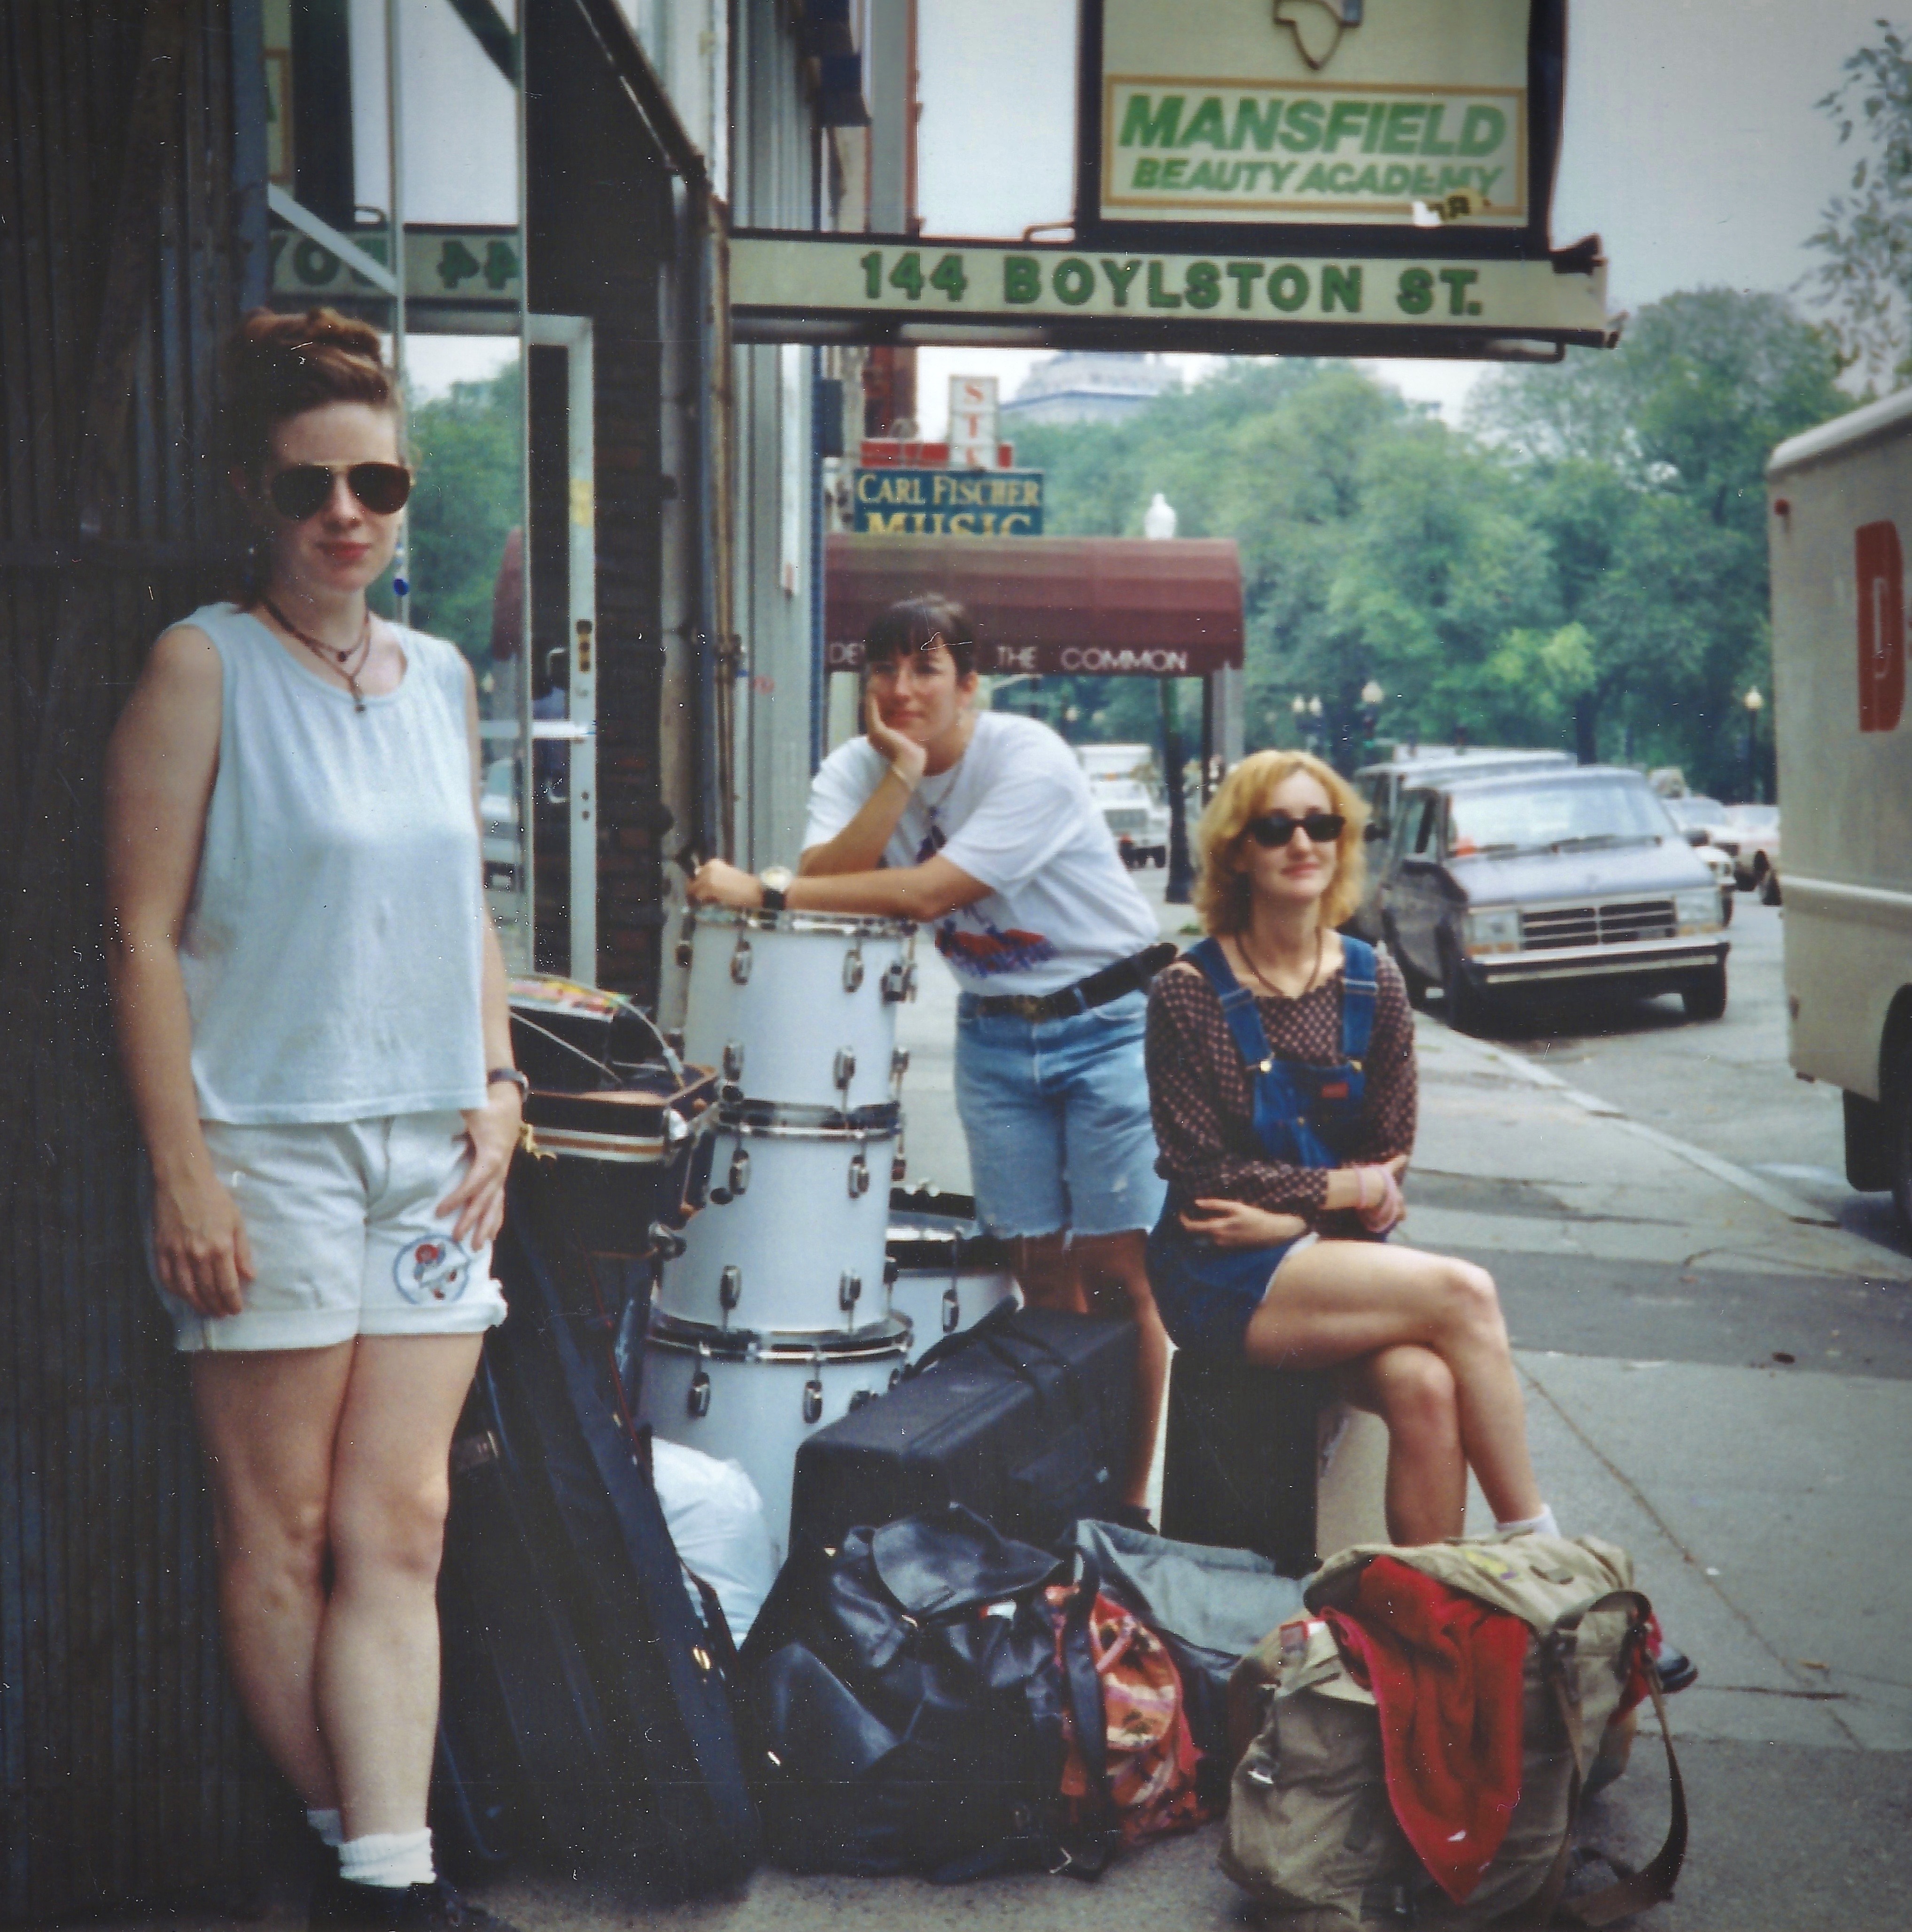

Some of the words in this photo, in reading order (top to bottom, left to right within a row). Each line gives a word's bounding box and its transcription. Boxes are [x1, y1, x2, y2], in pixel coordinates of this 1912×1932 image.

[1118, 94, 1507, 157] MANSFIELD
[1130, 156, 1299, 192] BEAUTY
[1293, 160, 1505, 197] ACADEMY
[861, 250, 969, 303] 144
[1003, 255, 1364, 312] BOYLSTON
[1396, 266, 1484, 316] ST.
[856, 473, 925, 504] CARL
[933, 475, 1039, 506] FISCHER
[996, 646, 1038, 668] THE
[1060, 647, 1187, 671] COMMON
